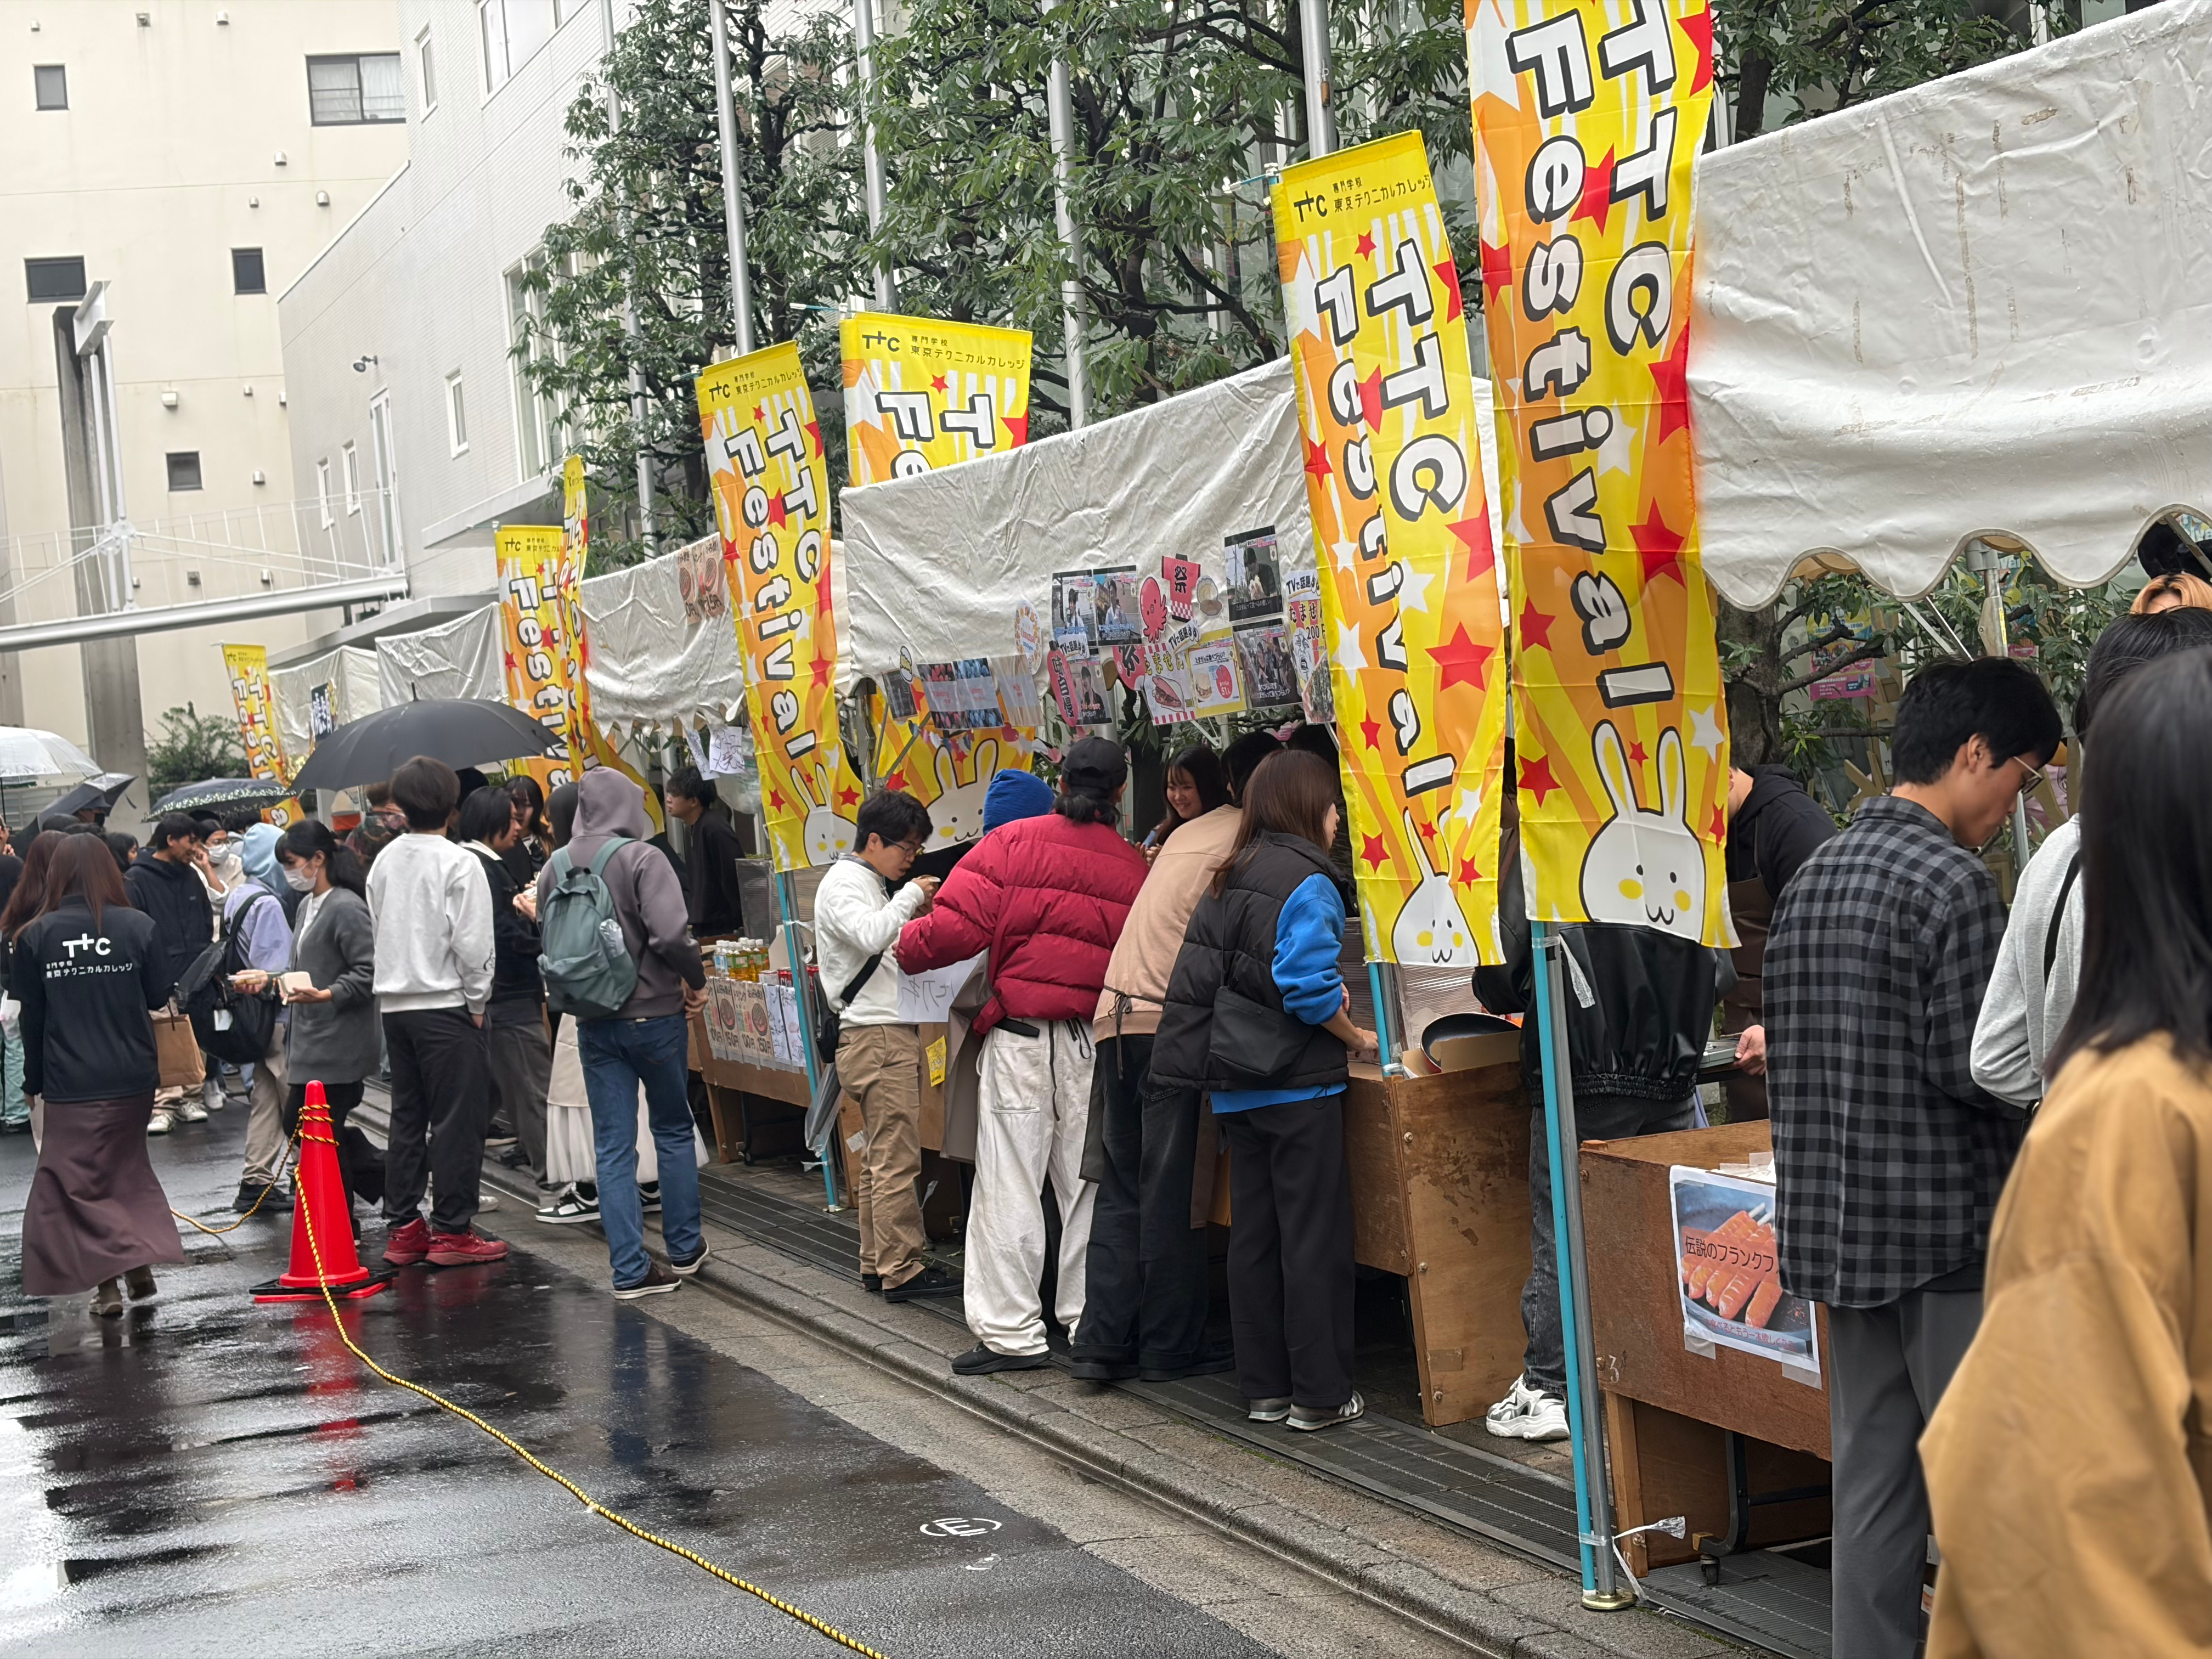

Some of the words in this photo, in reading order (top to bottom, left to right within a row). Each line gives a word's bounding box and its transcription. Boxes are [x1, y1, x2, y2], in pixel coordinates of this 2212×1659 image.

[1333, 177, 1362, 193] 専門学校
[1334, 174, 1431, 213] 東京テクニカルカレッジ
[1598, 0, 1677, 356] TTC
[911, 335, 947, 347] 専門学校
[911, 345, 1025, 369] 東京テクニカルカレッジ
[1505, 9, 1674, 708] Festival
[736, 367, 802, 394] 東京テクニカルカレッジ
[1365, 238, 1466, 522] TTC
[765, 408, 821, 584] TTC
[1314, 263, 1457, 798] Festival
[724, 426, 816, 760] Festival
[1175, 565, 1187, 594] 祭
[509, 576, 572, 789] Festiva
[249, 675, 278, 760] TTC
[46, 963, 133, 979] 東京テクニカルカレッジ
[1685, 1235, 1779, 1273] 伝説のフランクフ
